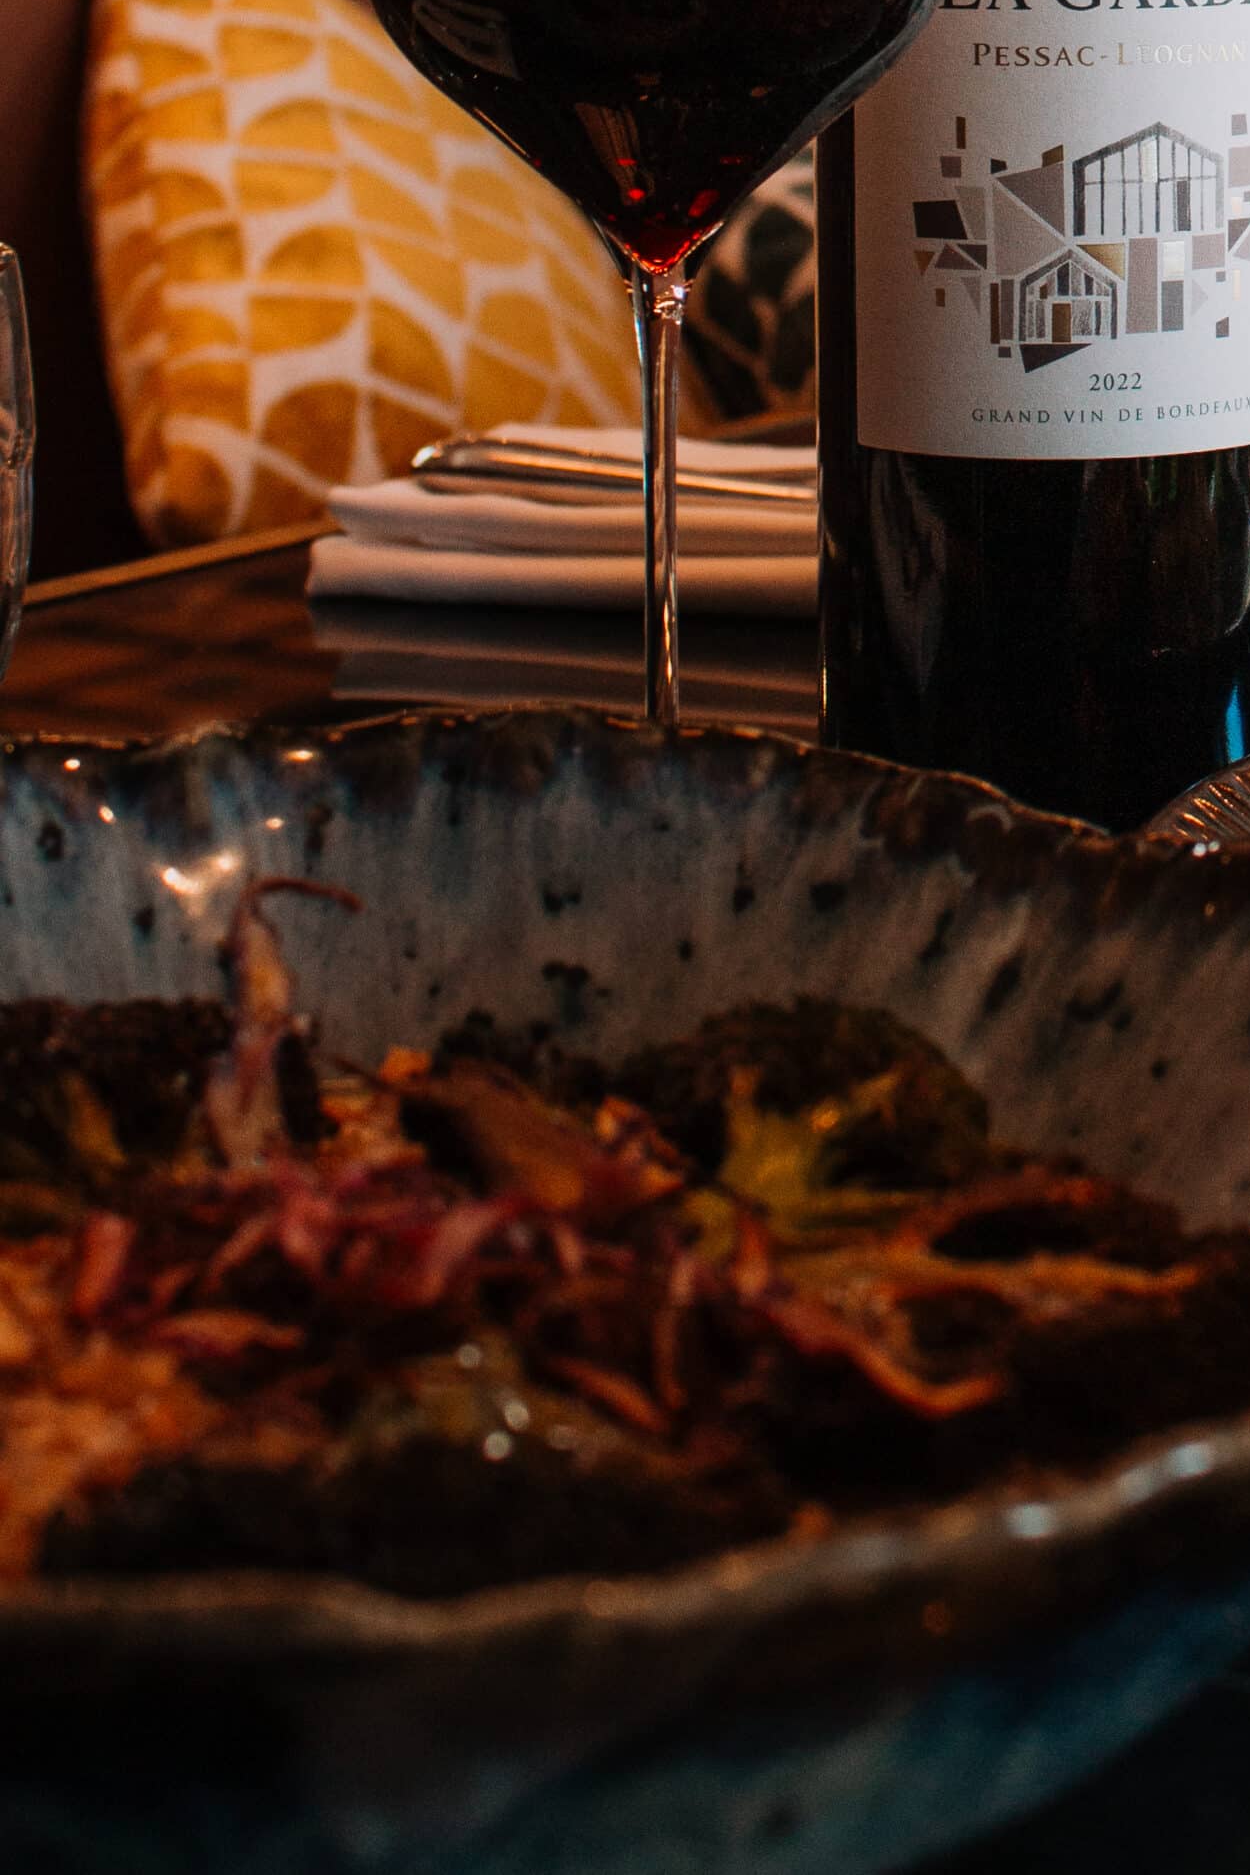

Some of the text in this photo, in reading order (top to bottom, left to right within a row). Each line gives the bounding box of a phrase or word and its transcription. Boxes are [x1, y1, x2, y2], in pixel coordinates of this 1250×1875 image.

[1088, 372, 1143, 392] 2022
[971, 407, 1051, 424] GRAND
[1063, 409, 1105, 424] VIN
[1118, 407, 1144, 423] DE
